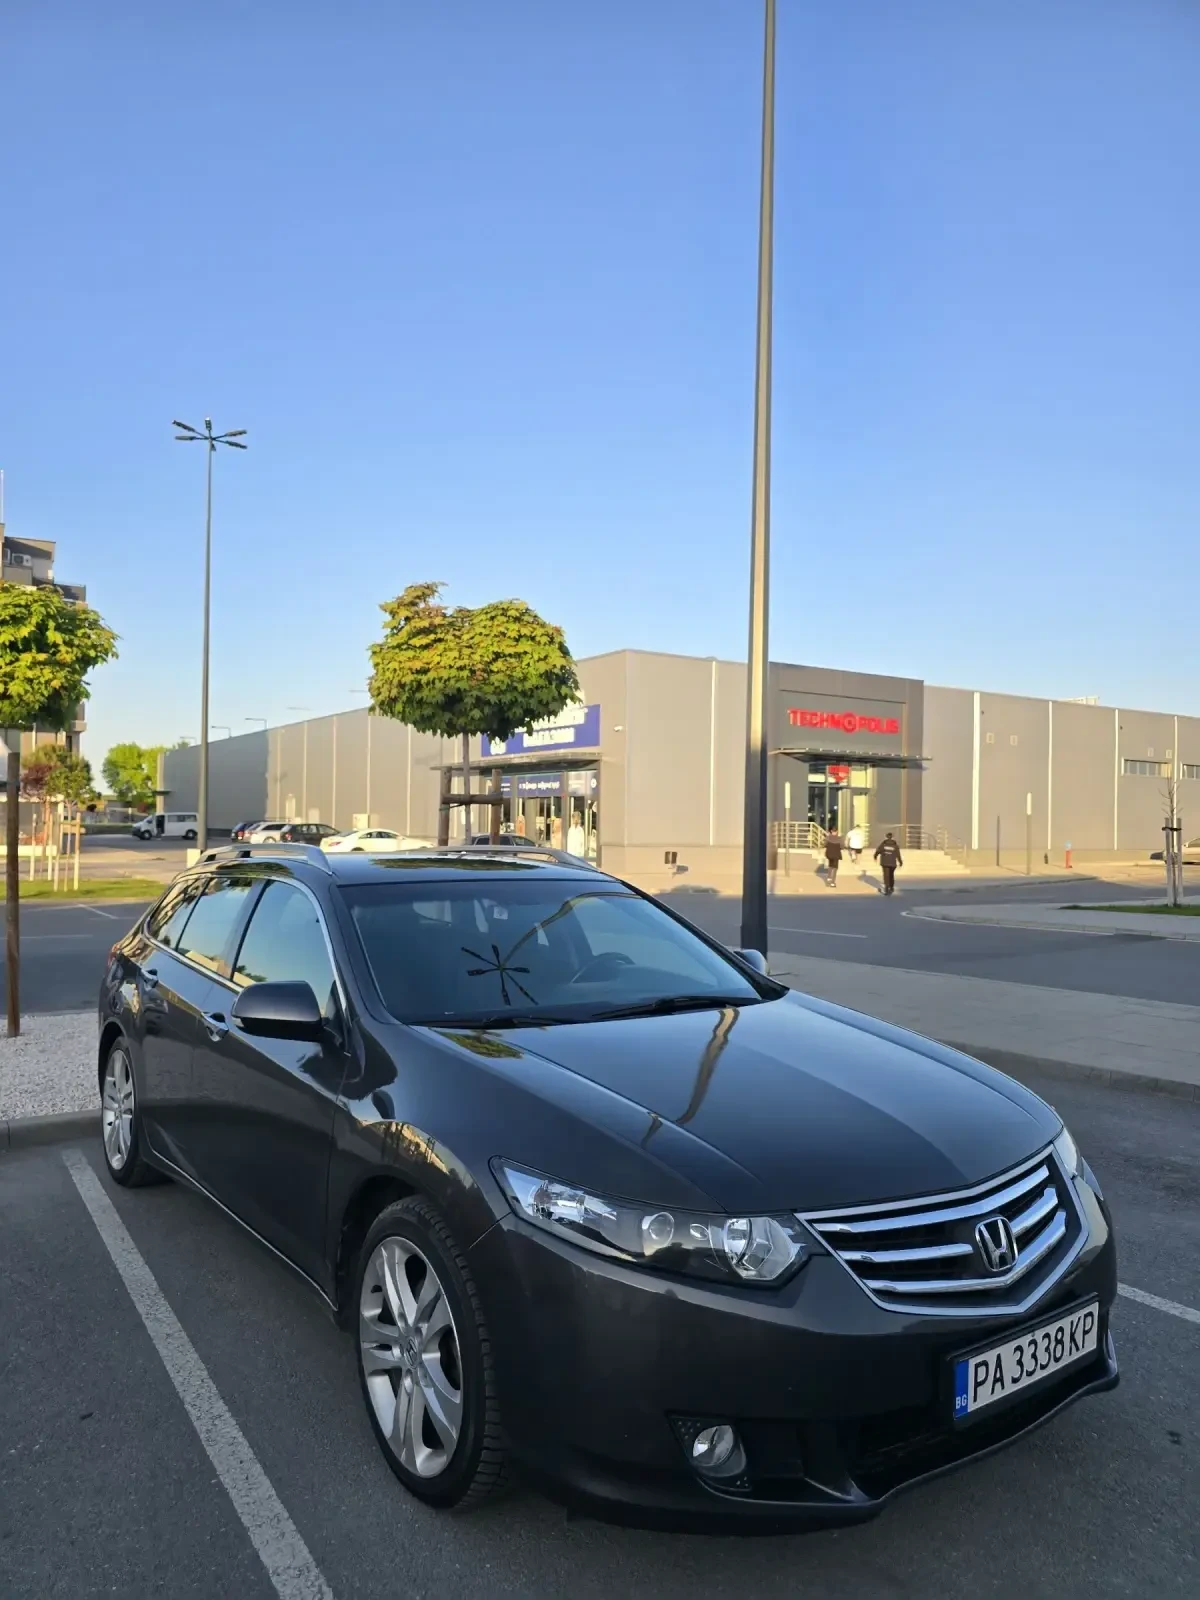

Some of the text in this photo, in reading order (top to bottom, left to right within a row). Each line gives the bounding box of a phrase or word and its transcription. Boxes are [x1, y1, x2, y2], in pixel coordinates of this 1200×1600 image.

[787, 708, 901, 734] TECHNOPOLIS
[972, 1310, 1095, 1403] PA 3338 KP
[955, 1395, 967, 1409] BG
